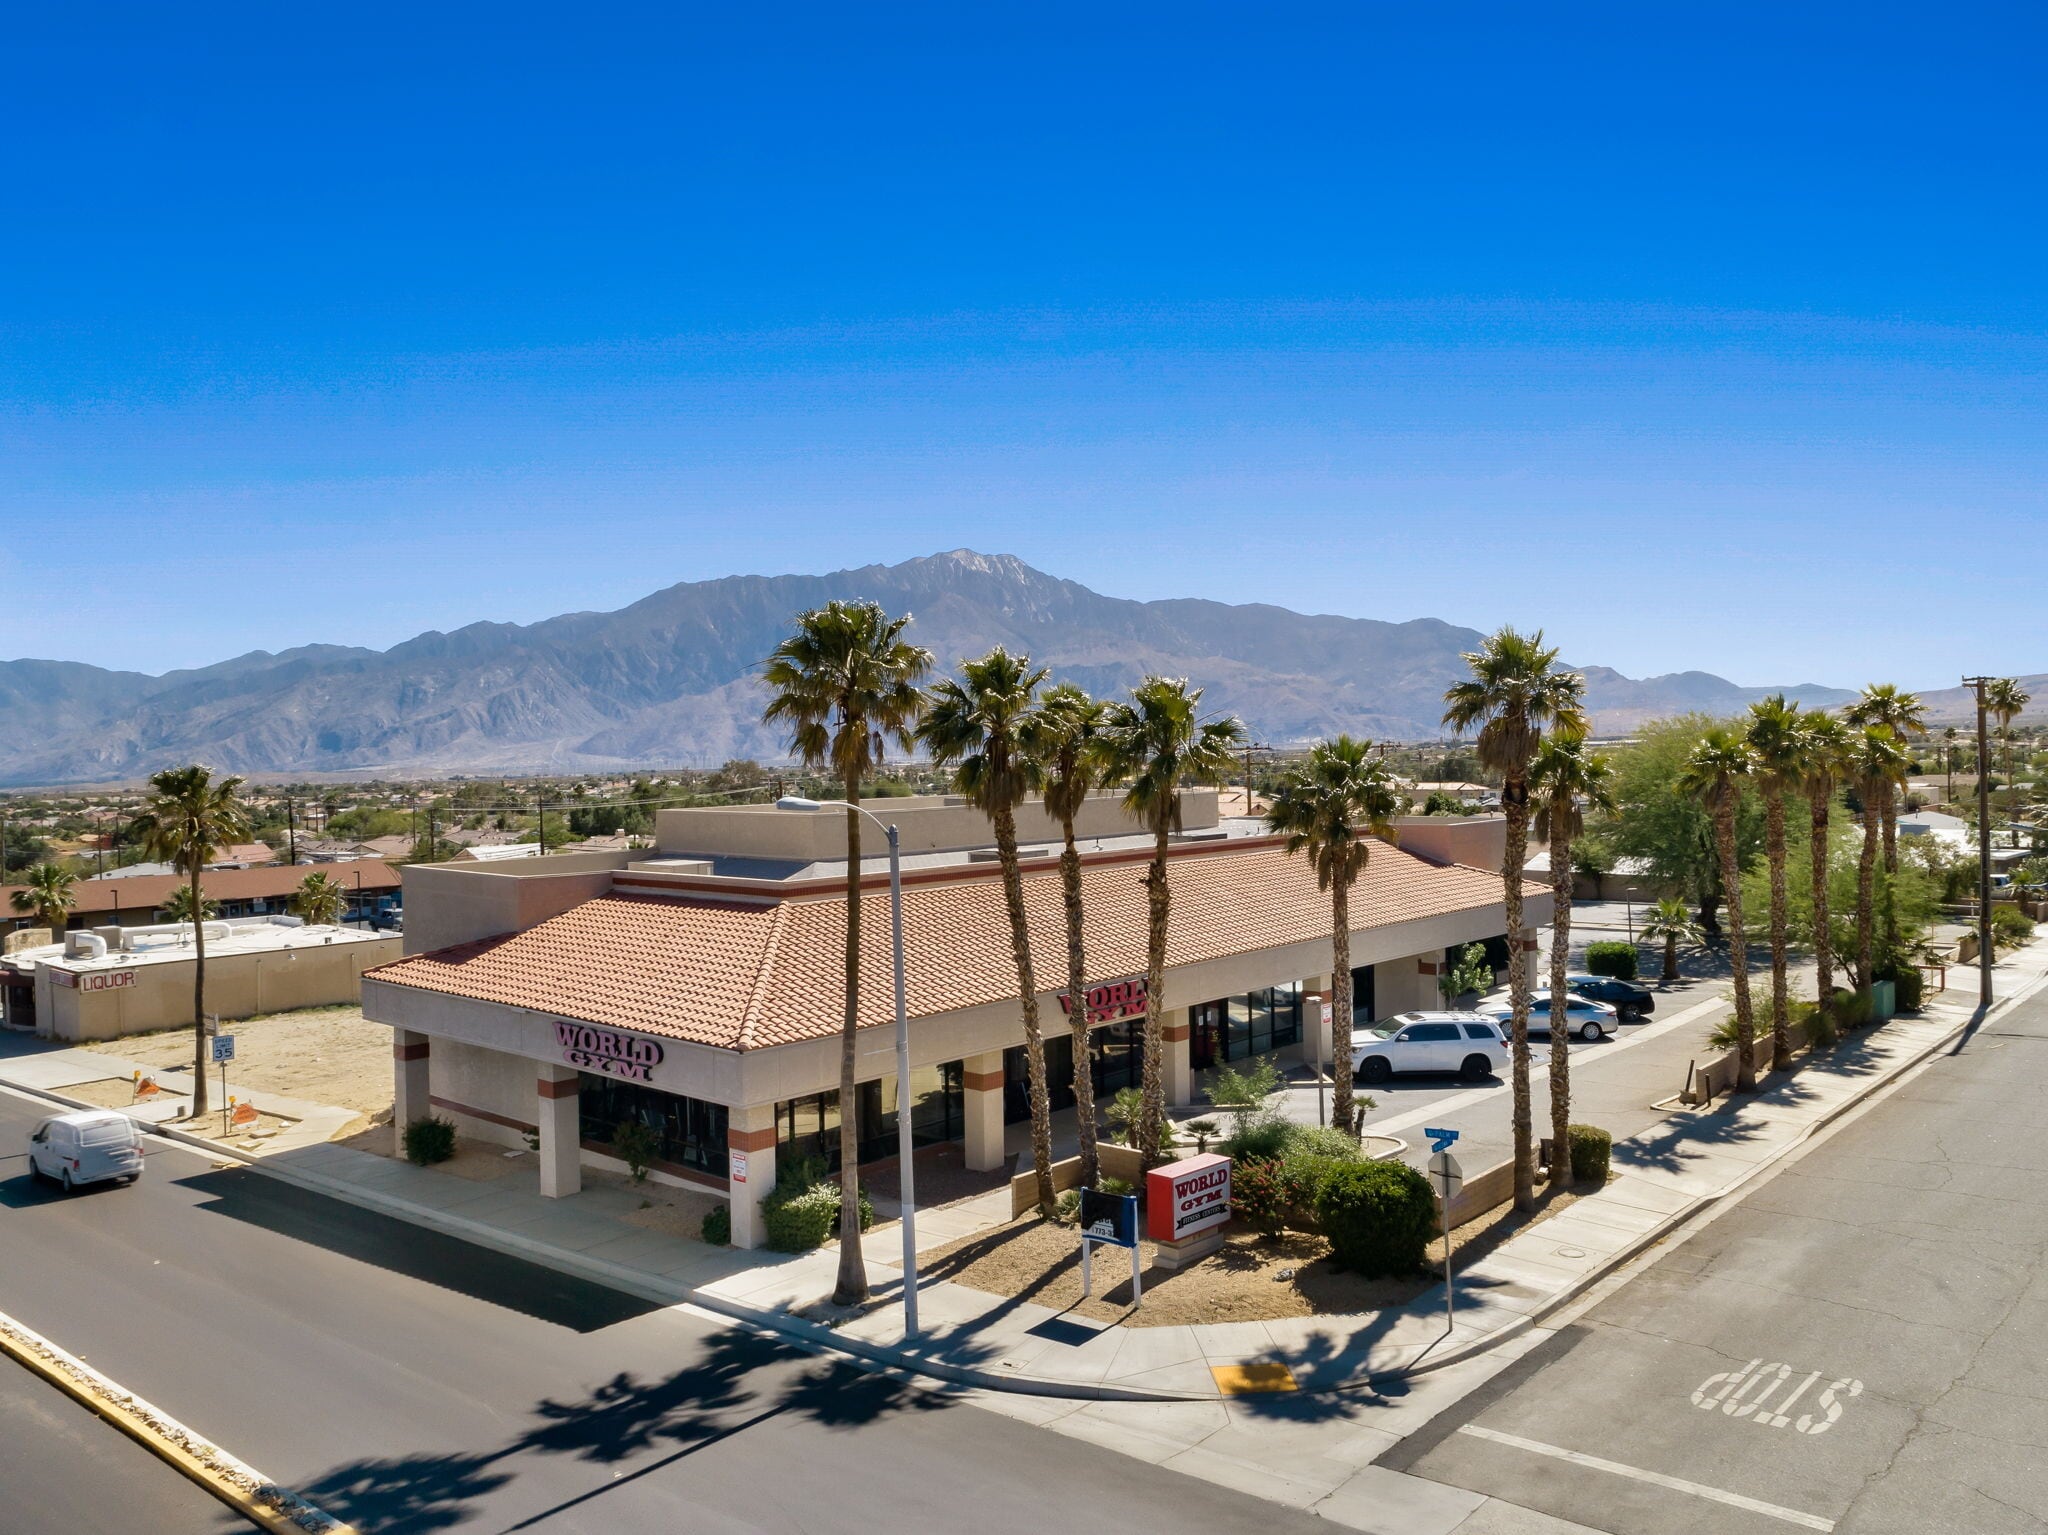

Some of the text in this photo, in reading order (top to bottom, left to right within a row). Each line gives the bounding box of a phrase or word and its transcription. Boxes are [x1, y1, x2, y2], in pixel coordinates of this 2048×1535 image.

[83, 971, 135, 992] LIQUOR
[215, 1047, 232, 1058] 35
[552, 1021, 664, 1067] WORLD
[563, 1048, 652, 1082] GYM
[1175, 1168, 1228, 1199] WORLD
[1181, 1188, 1223, 1212] GYM
[1183, 1211, 1201, 1225] FITNESS
[1691, 1358, 1864, 1435] STOP
